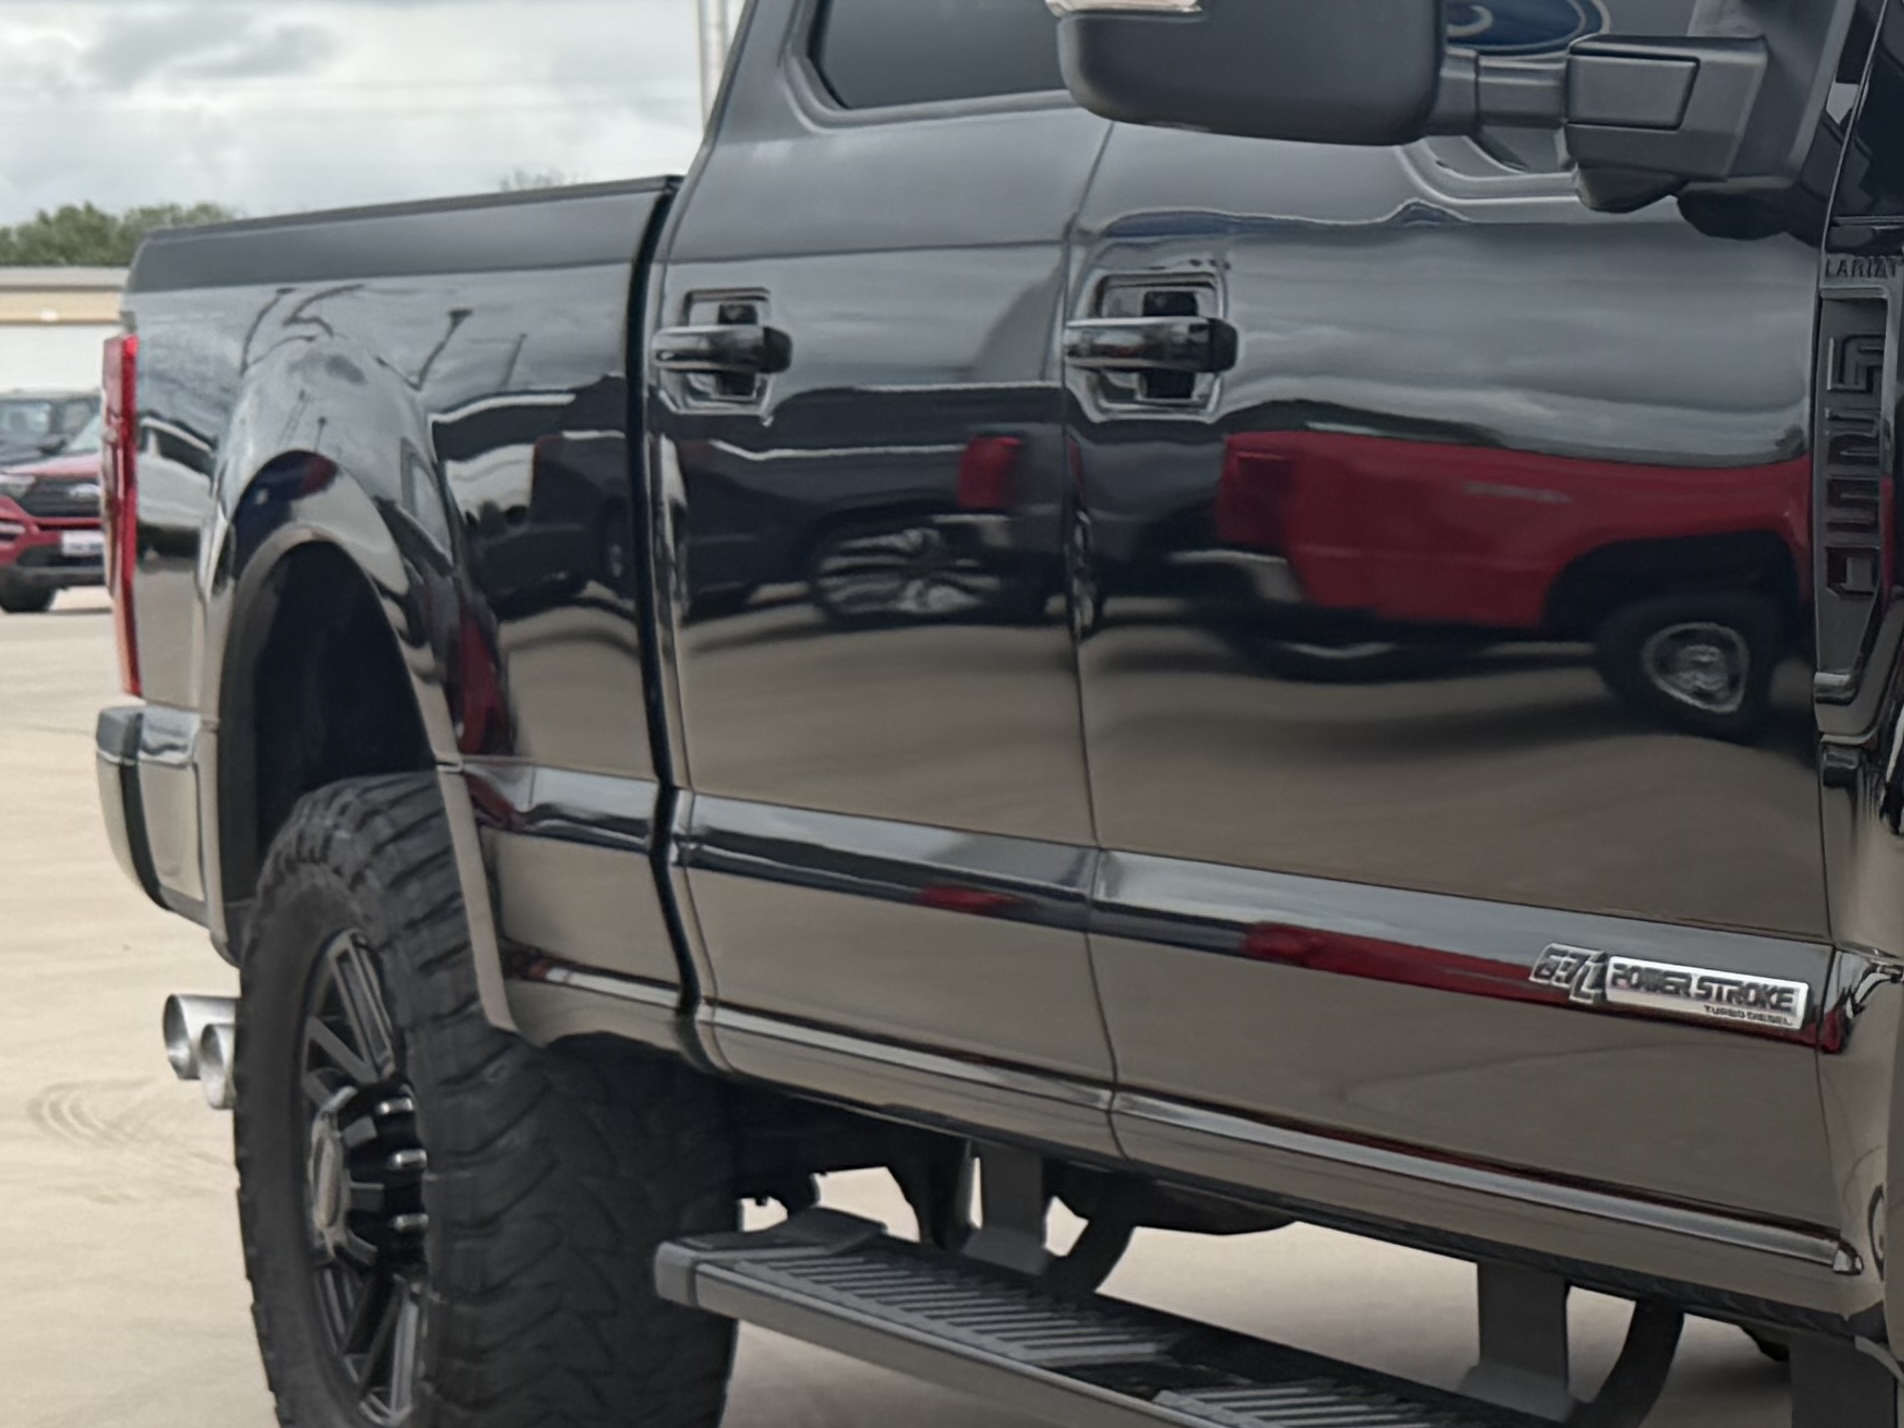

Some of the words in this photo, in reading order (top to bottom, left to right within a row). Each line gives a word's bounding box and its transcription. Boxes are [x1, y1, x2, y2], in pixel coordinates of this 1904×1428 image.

[1824, 256, 1904, 279] LARIAT
[1611, 963, 1692, 997] POWER
[1696, 974, 1795, 1011] STROKE
